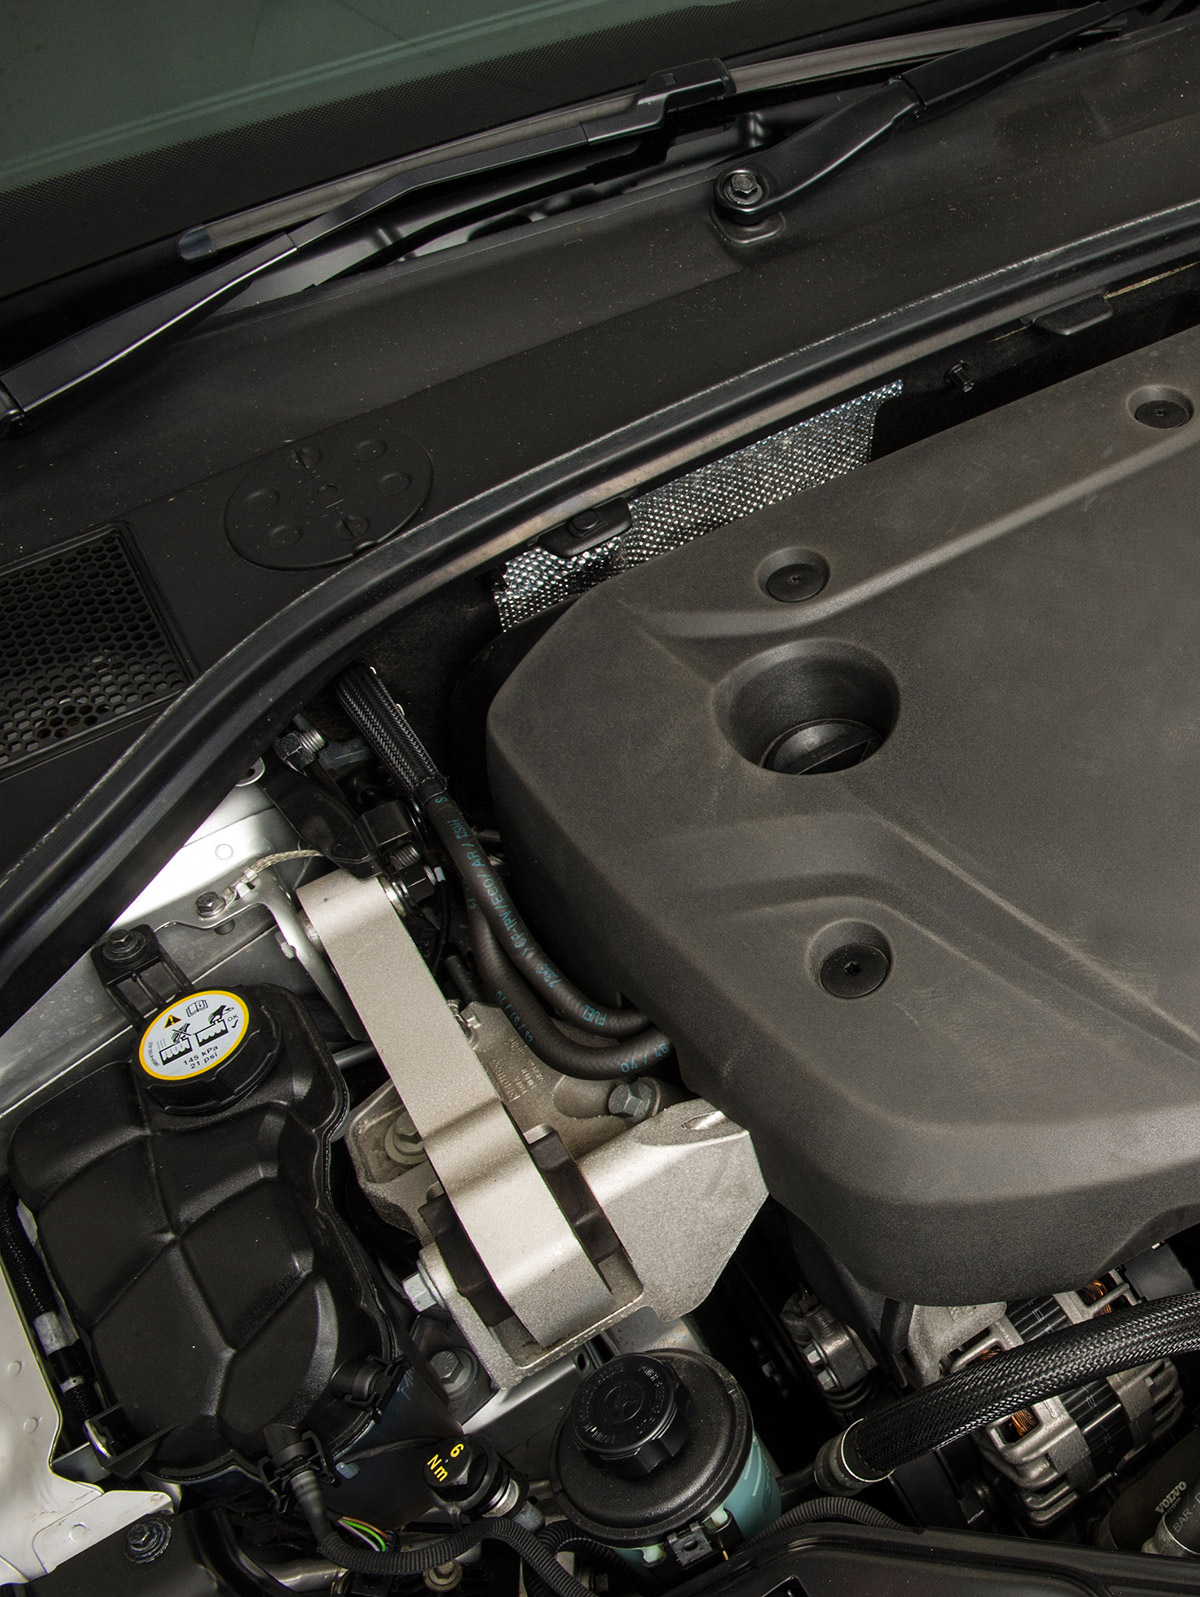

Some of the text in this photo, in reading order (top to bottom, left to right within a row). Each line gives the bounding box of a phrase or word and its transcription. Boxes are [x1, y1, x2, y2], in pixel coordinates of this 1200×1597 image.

[227, 1014, 239, 1022] OK
[581, 1004, 607, 1026] FUEL
[183, 1045, 219, 1066] 145 kPa
[190, 1052, 219, 1070] 21 psi
[450, 1443, 464, 1457] 6
[427, 1454, 448, 1482] Nm
[1155, 1481, 1187, 1513] VOLVO
[1173, 1508, 1193, 1533] BAR
